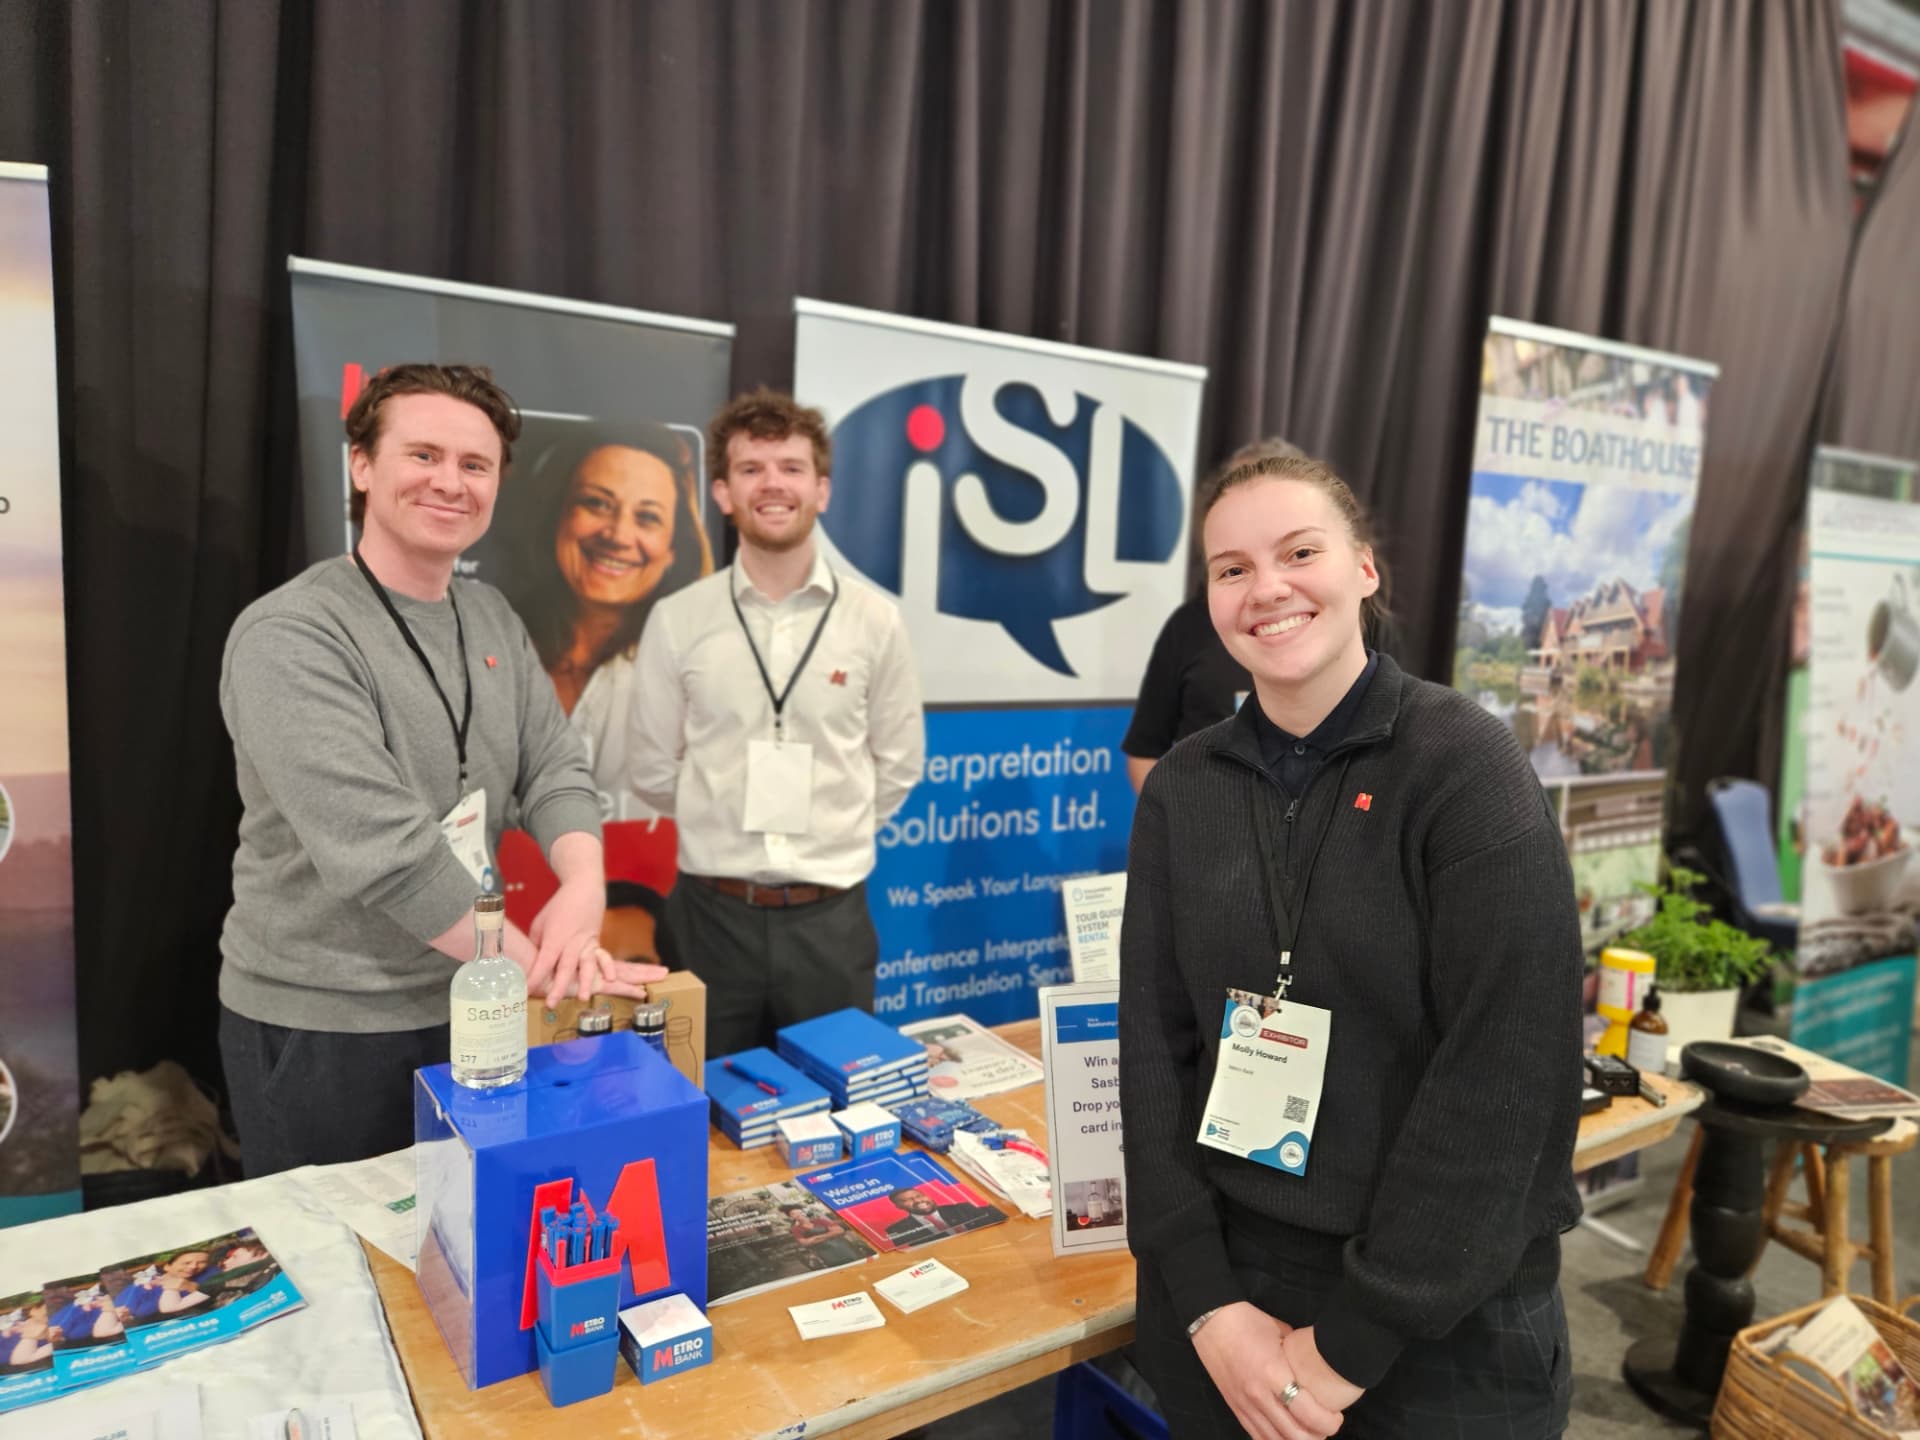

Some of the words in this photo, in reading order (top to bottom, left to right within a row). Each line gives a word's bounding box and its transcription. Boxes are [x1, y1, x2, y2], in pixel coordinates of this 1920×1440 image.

[1486, 415, 1545, 459] THE
[925, 737, 1111, 792] erpretation
[1051, 789, 1107, 832] Ltd.
[887, 886, 918, 908] We
[922, 878, 976, 909] Speak
[980, 875, 1018, 897] Your
[875, 947, 979, 979] onference
[984, 932, 1069, 962] Interpret
[912, 969, 1022, 1007] Translation
[1084, 1056, 1108, 1068] Win
[1232, 1042, 1254, 1057] Molly
[1256, 1049, 1288, 1064] Howard
[1073, 1100, 1103, 1113] Drop
[1105, 1100, 1121, 1113] yo
[1081, 1121, 1108, 1134] card
[864, 1178, 881, 1187] in
[832, 1184, 895, 1206] business
[144, 1322, 196, 1345] About
[199, 1318, 219, 1328] us
[570, 1316, 605, 1339] METRO
[70, 1349, 125, 1370] About
[653, 1337, 703, 1372] METRO
[674, 1349, 703, 1366] BANK
[0, 1378, 42, 1395] bout
